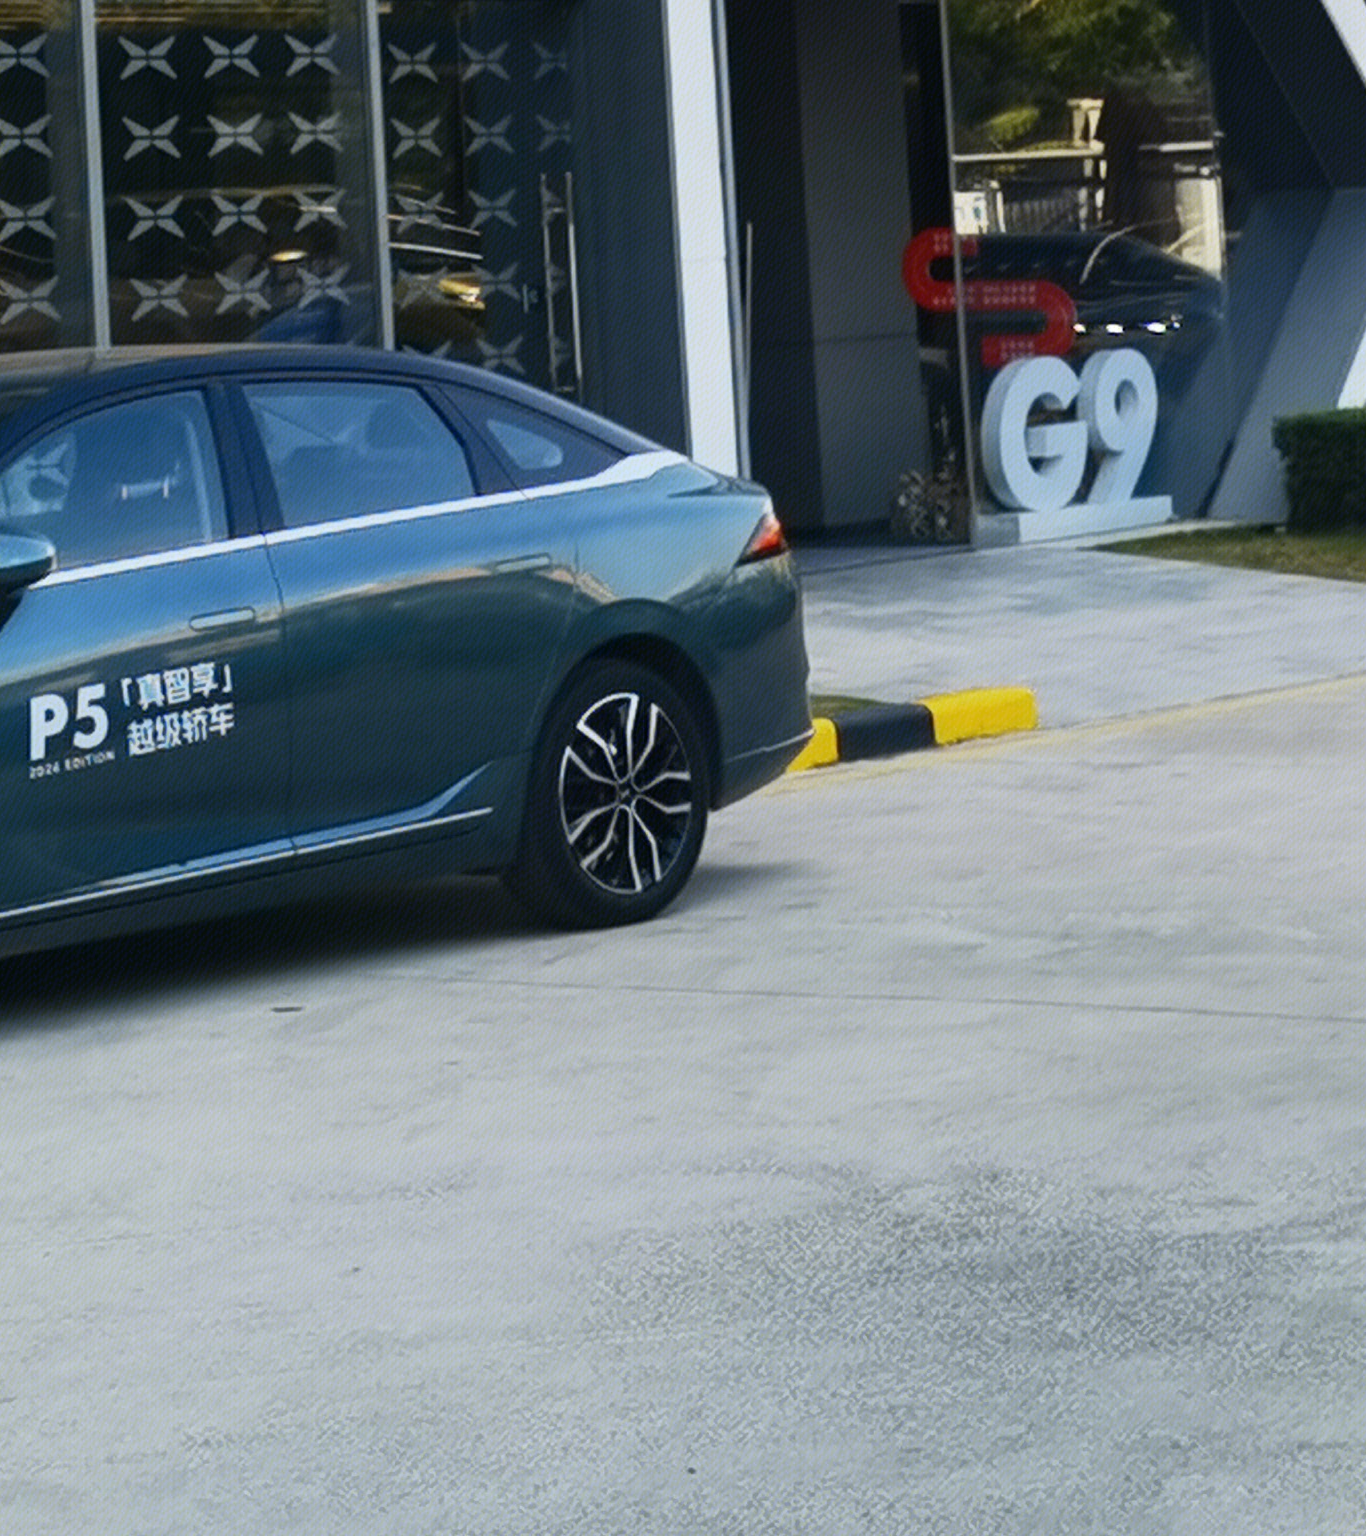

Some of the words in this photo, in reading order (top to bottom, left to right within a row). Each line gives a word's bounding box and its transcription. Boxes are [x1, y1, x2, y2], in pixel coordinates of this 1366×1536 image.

[981, 347, 1157, 513] G9
[29, 684, 109, 762] P5
[64, 750, 115, 771] EDITION
